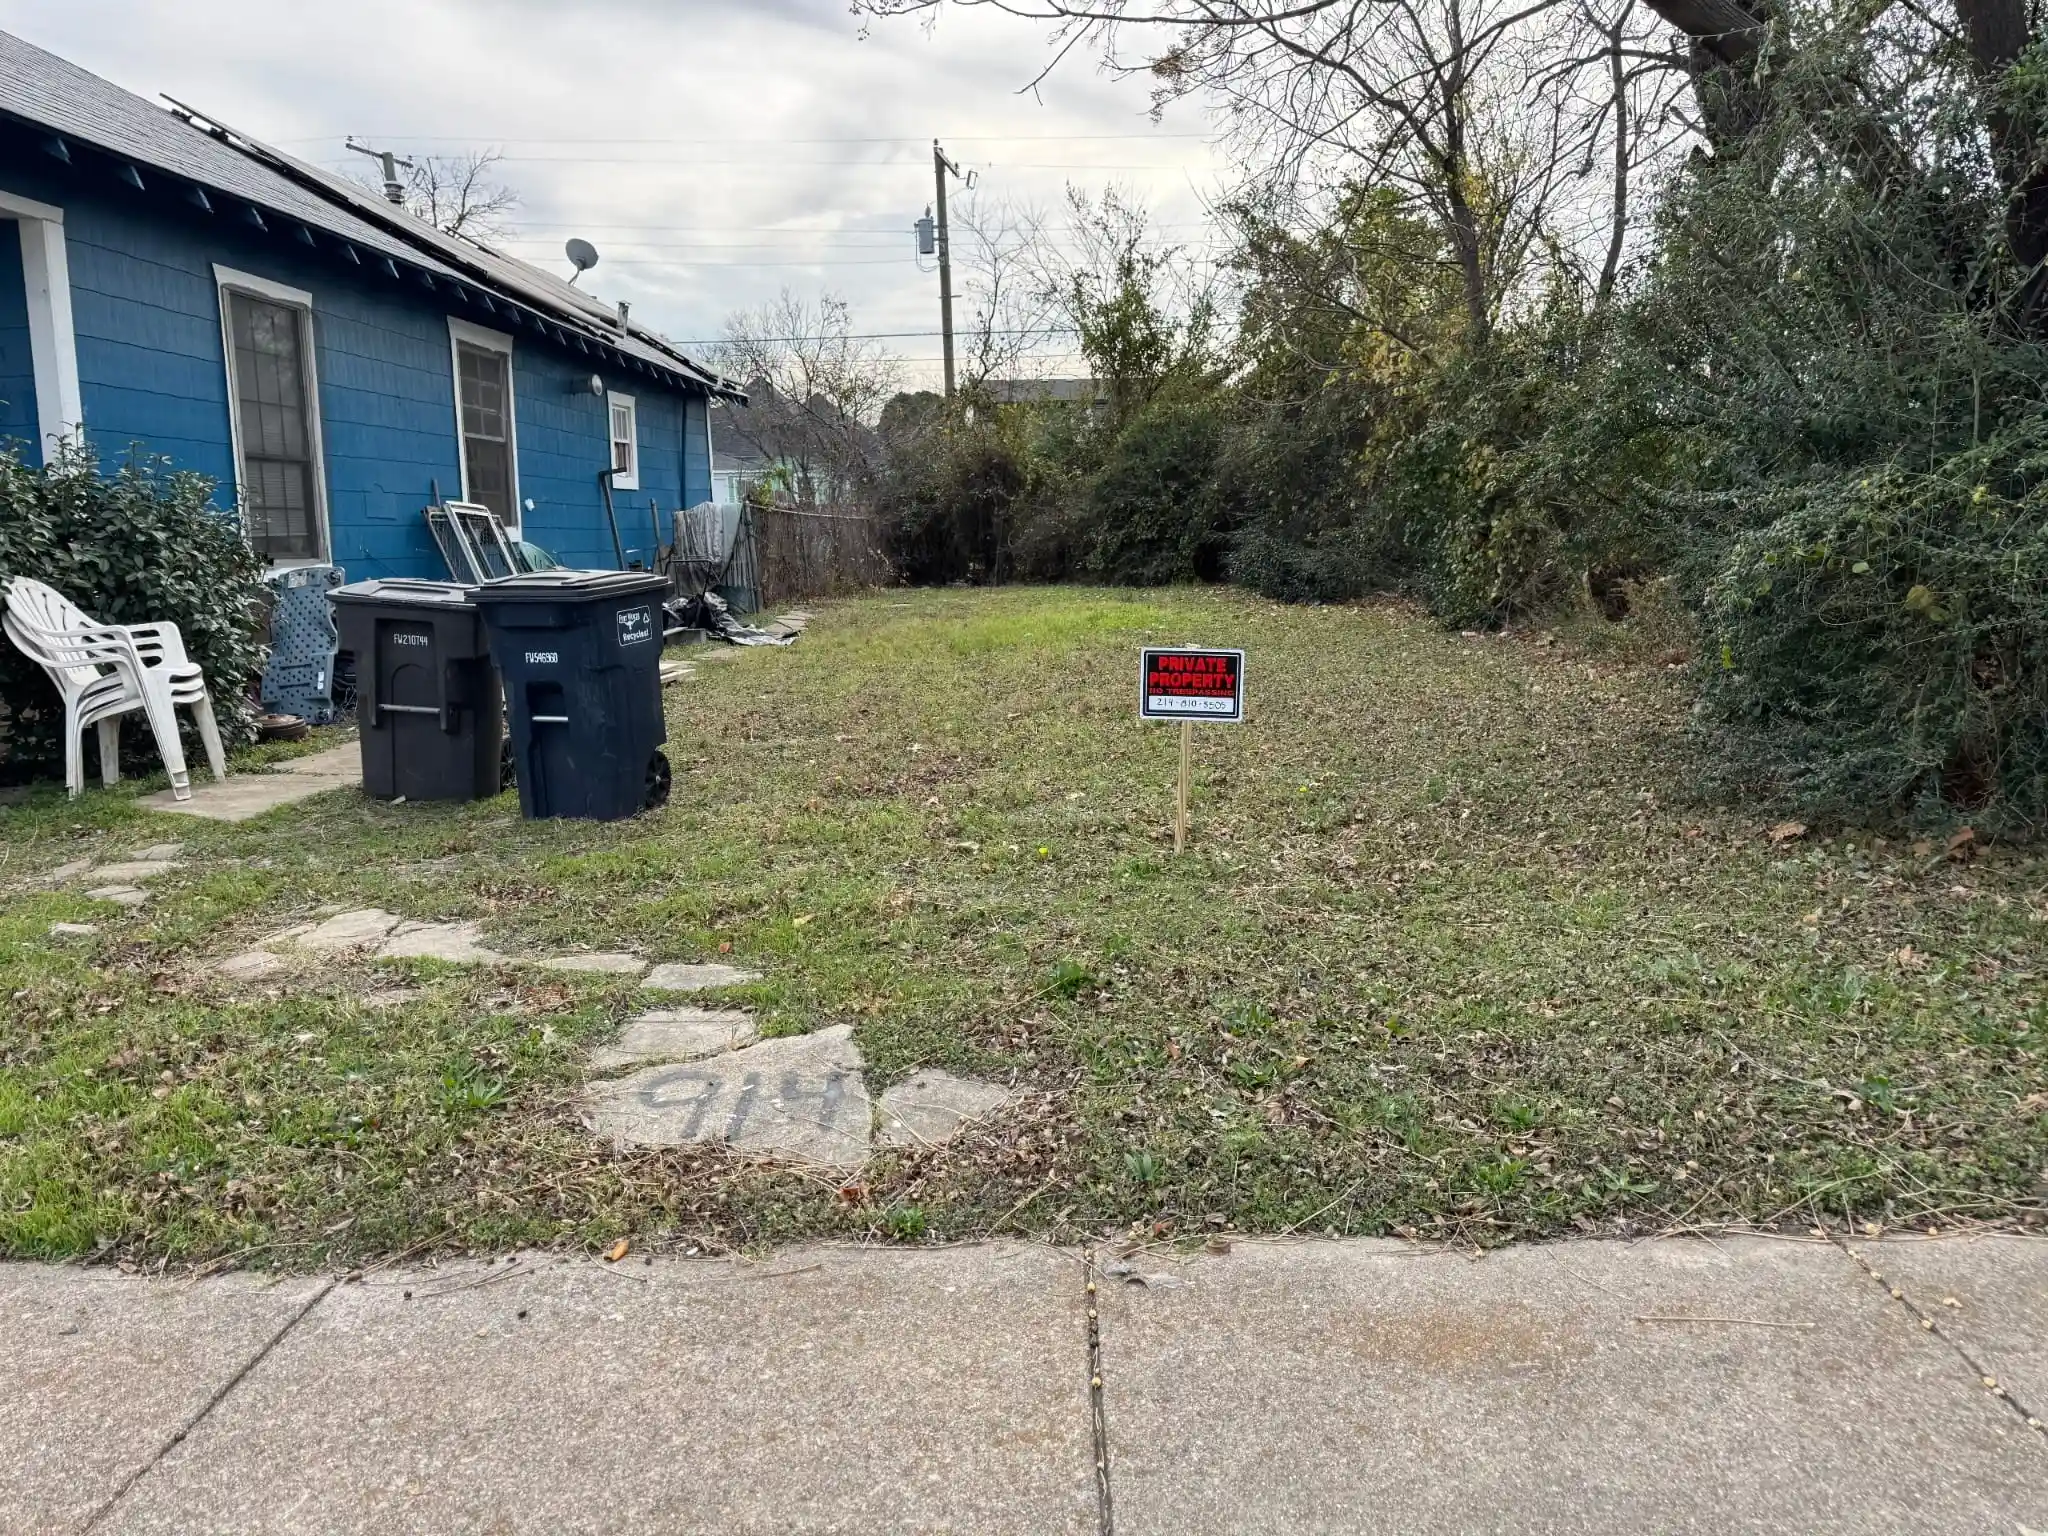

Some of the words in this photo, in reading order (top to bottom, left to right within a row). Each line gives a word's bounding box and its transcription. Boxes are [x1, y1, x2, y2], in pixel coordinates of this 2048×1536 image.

[1158, 656, 1228, 672] PRIVATE
[1149, 672, 1235, 688] PROPERTY
[1166, 688, 1234, 696] TRESPASSING
[639, 1070, 847, 1140] 914
